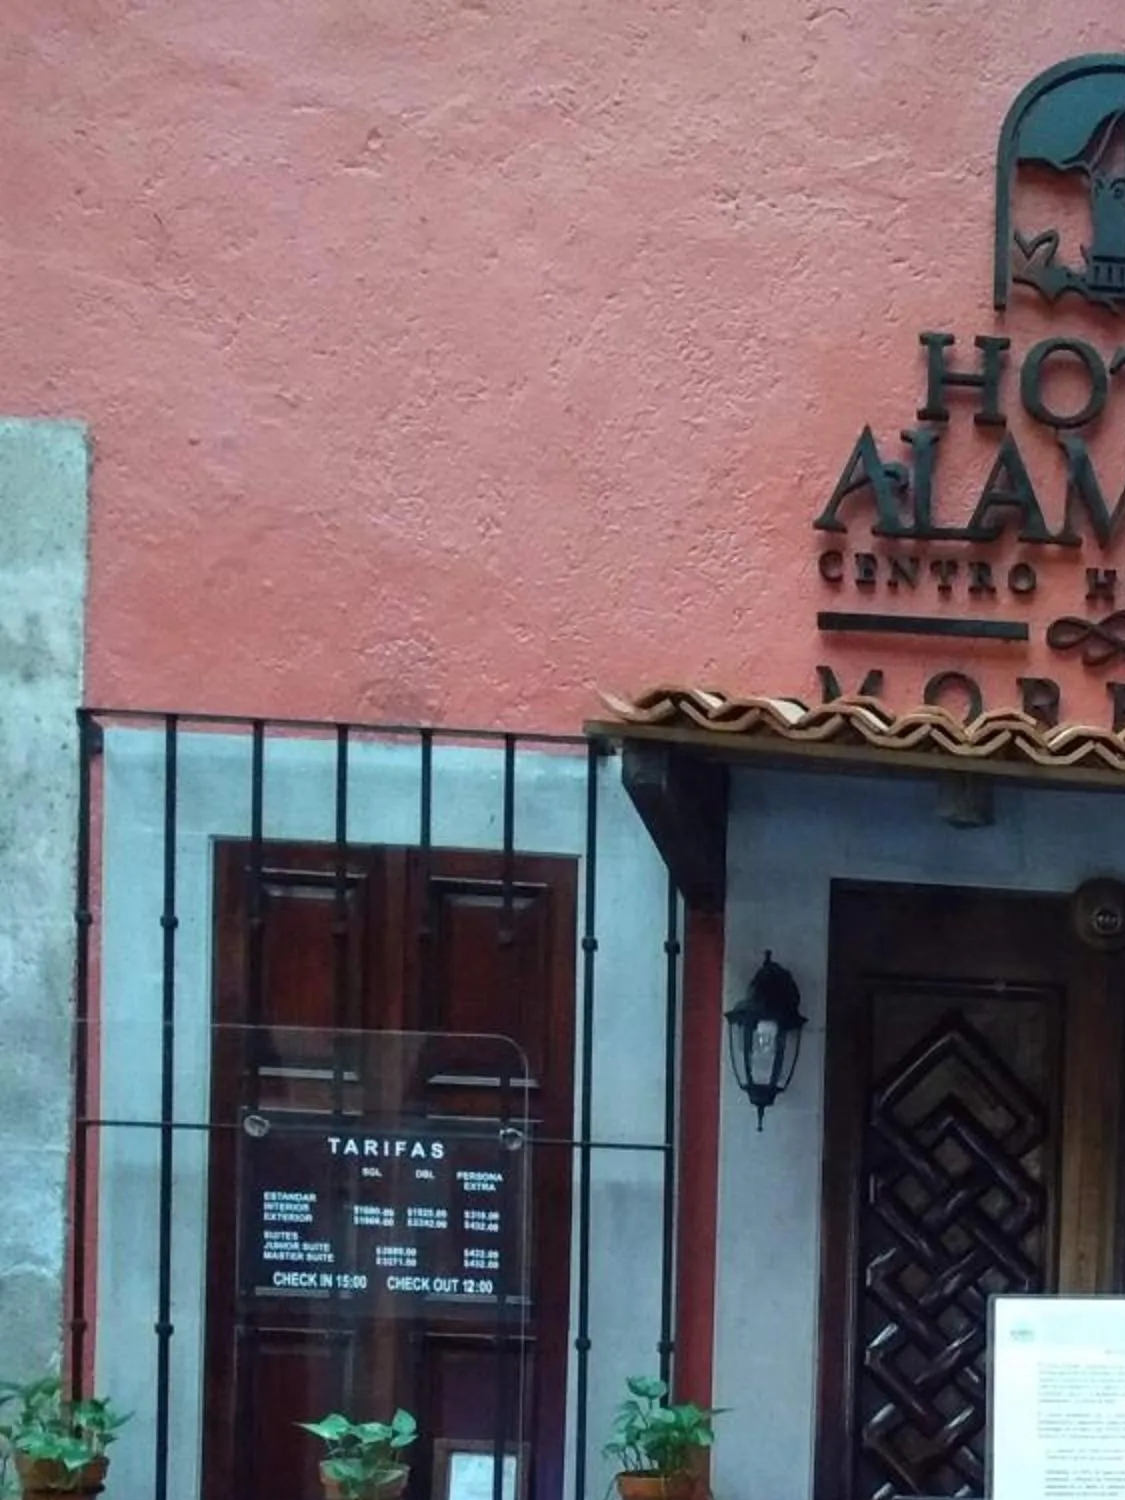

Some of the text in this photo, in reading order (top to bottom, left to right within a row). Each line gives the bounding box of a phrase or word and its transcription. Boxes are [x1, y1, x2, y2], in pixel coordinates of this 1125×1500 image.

[818, 550, 1037, 594] CENTRO
[327, 1137, 446, 1160] TARIFAS
[463, 1181, 496, 1191] EXTRA
[272, 1271, 368, 1289] CHECK IN 15:00
[387, 1275, 494, 1294] CHECK OUT 12:00
